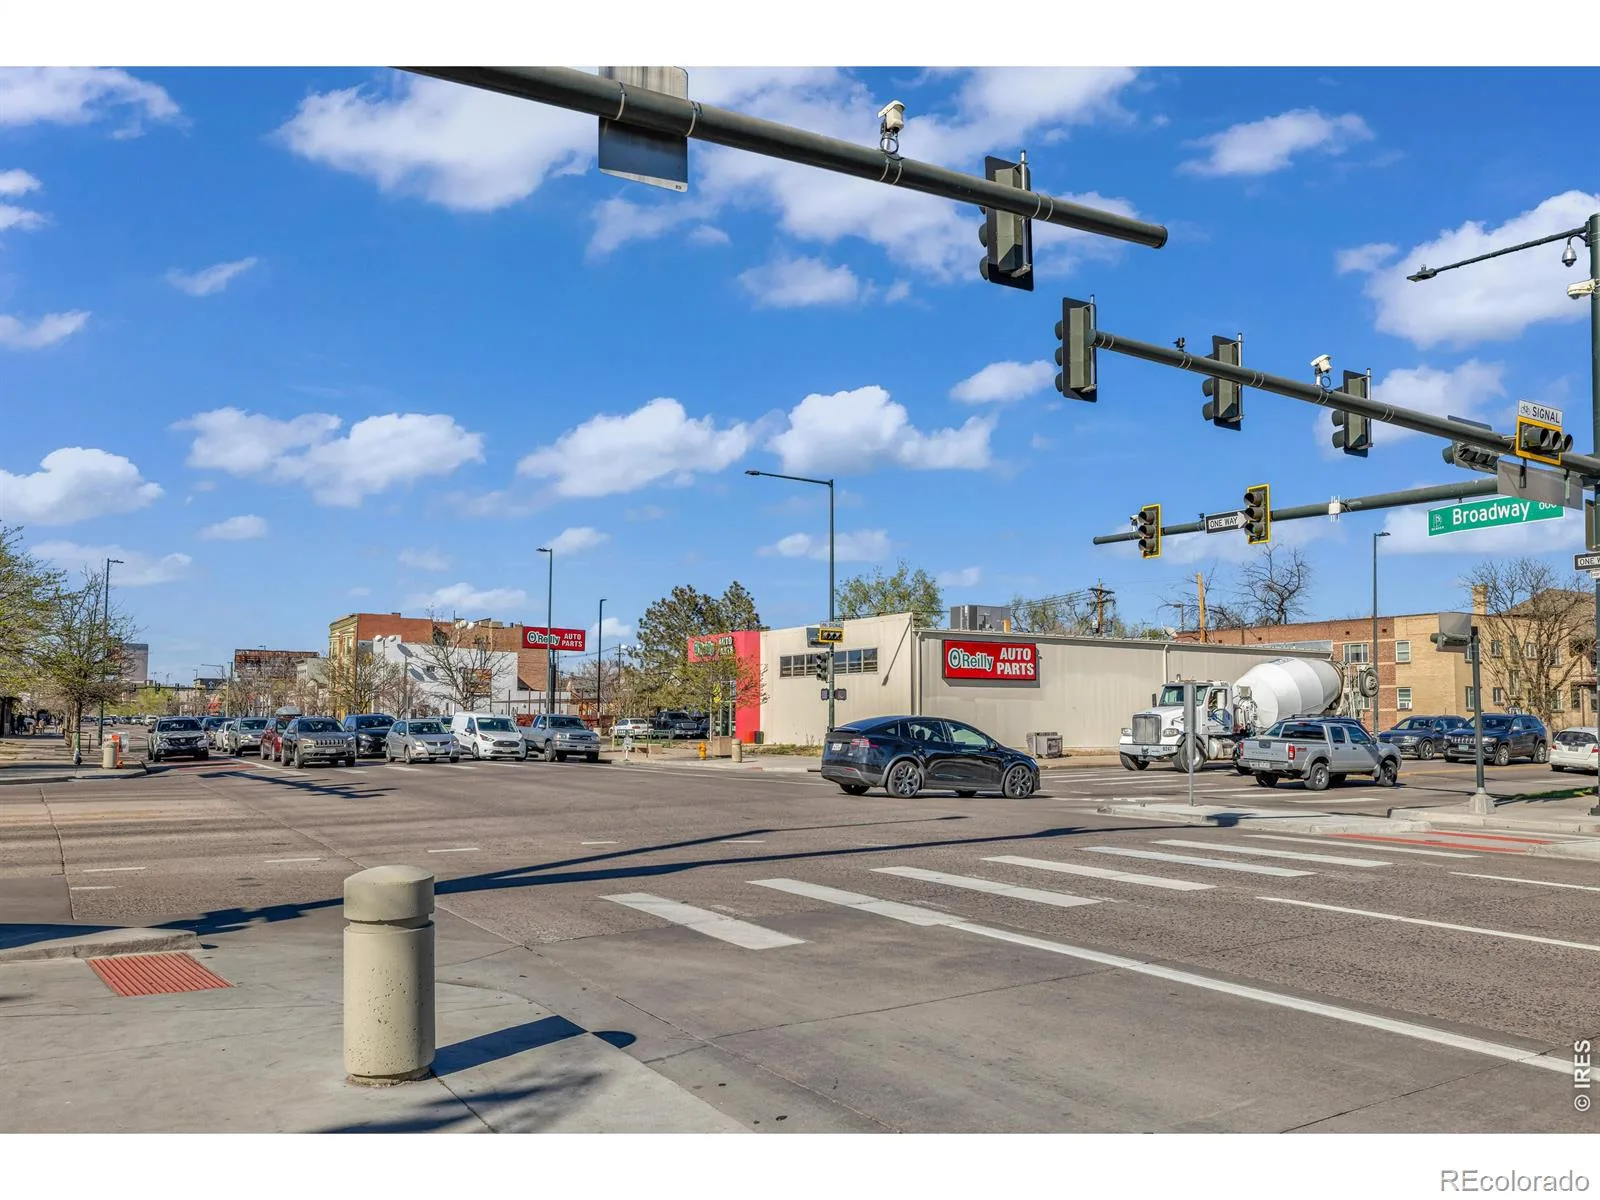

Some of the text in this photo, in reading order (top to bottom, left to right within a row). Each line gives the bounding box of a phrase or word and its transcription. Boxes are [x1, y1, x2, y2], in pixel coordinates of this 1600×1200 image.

[1532, 406, 1560, 423] SIGNAL
[1452, 501, 1530, 525] Broadway
[1209, 516, 1238, 528] ONE WAY
[1579, 557, 1595, 566] ONE
[561, 640, 583, 648] PARTS
[948, 647, 995, 672] O'Reilly
[999, 647, 1032, 661] AUTO
[996, 662, 1035, 676] PARTS
